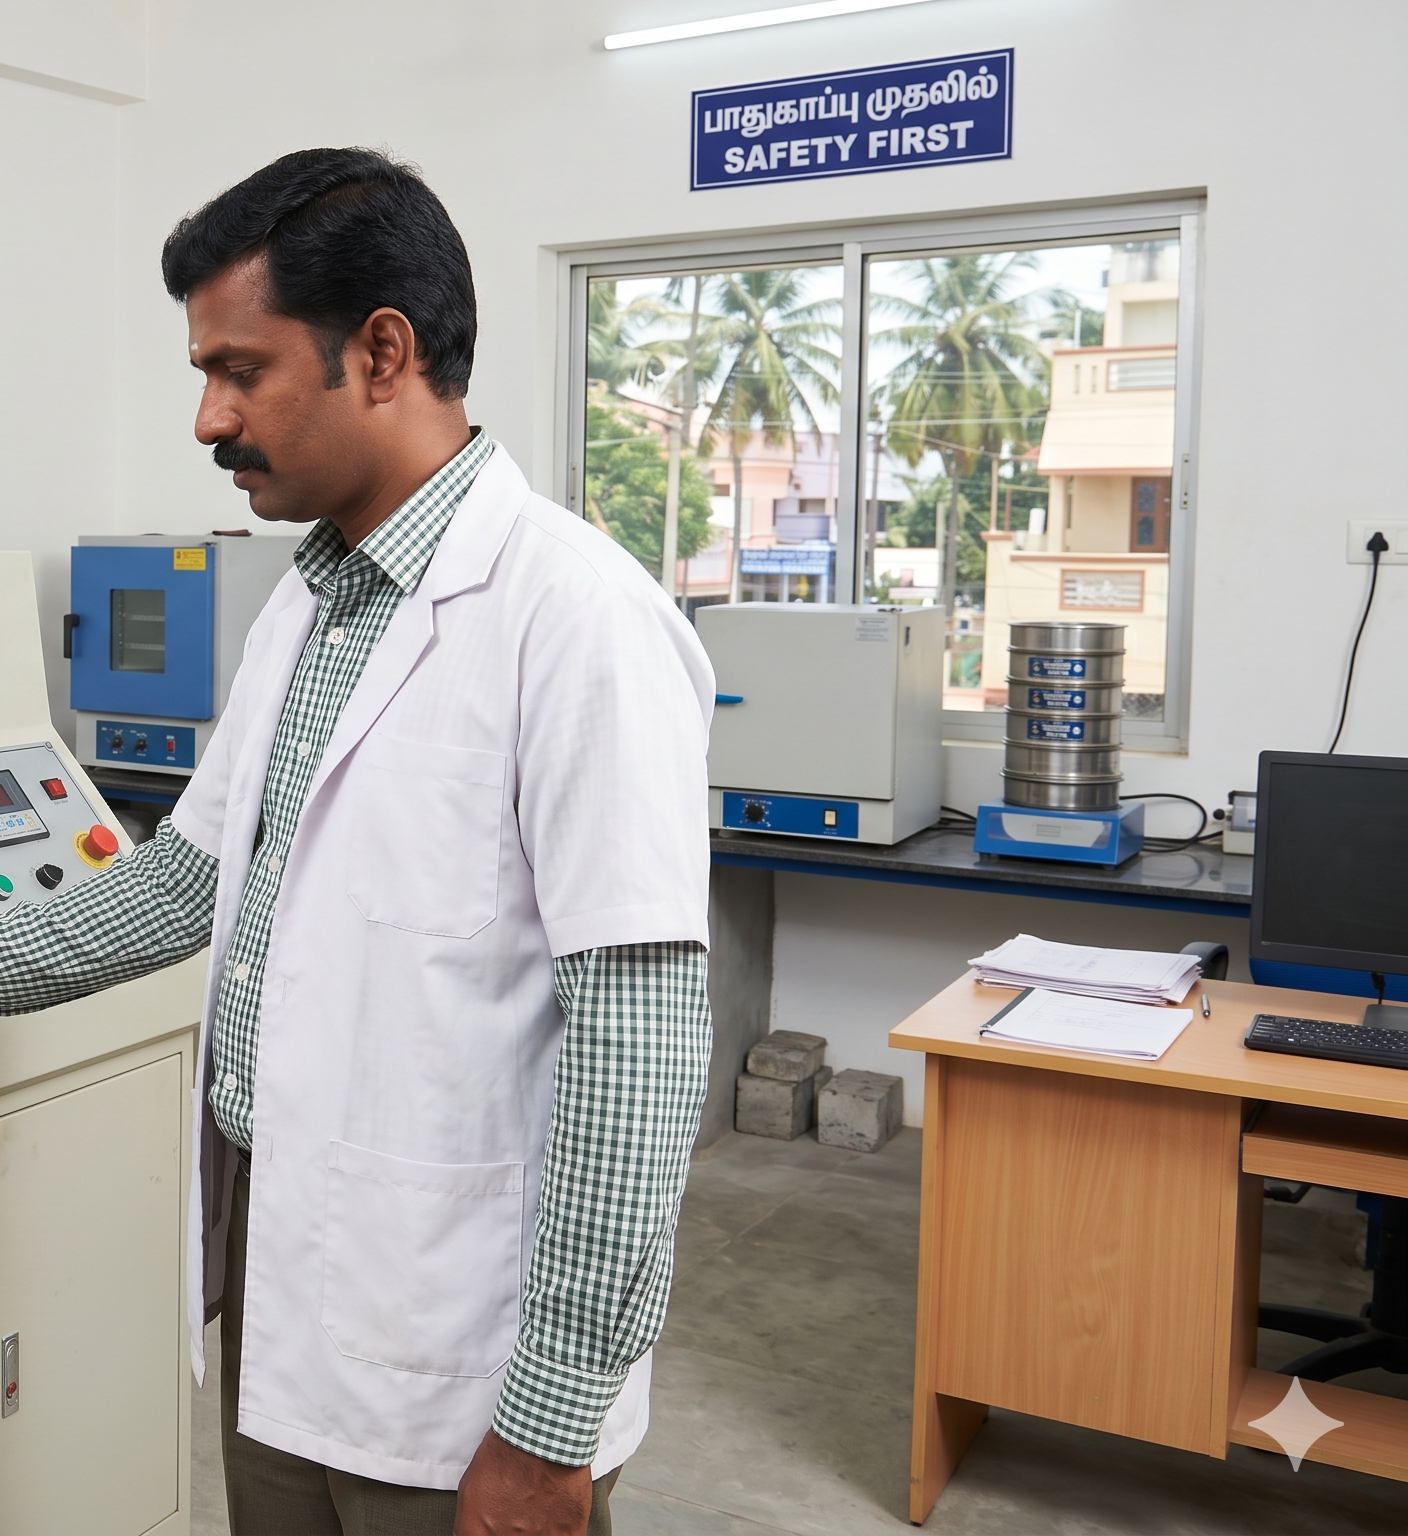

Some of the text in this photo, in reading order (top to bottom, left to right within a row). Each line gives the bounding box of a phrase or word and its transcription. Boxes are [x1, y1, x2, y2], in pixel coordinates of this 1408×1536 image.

[704, 65, 999, 138] பாதுகாப்பு முதலில்
[724, 120, 974, 174] SAFETY FIRST
